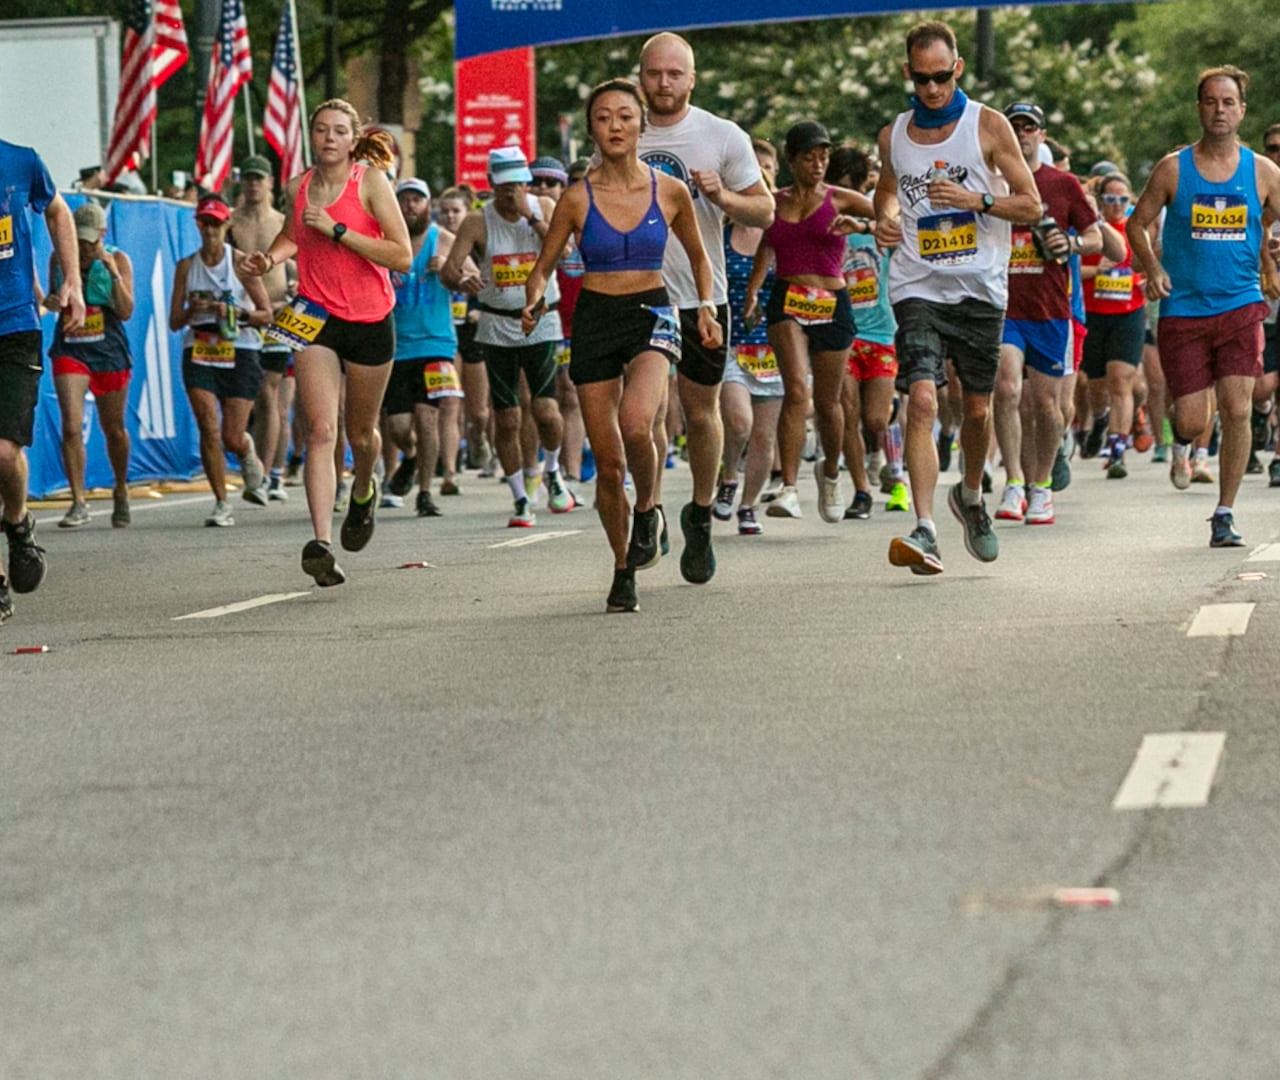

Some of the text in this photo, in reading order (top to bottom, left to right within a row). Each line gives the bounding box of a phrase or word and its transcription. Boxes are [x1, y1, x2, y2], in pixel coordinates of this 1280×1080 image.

[1195, 212, 1244, 225] D21634
[922, 233, 974, 251] D21418
[788, 298, 833, 315] D20920
